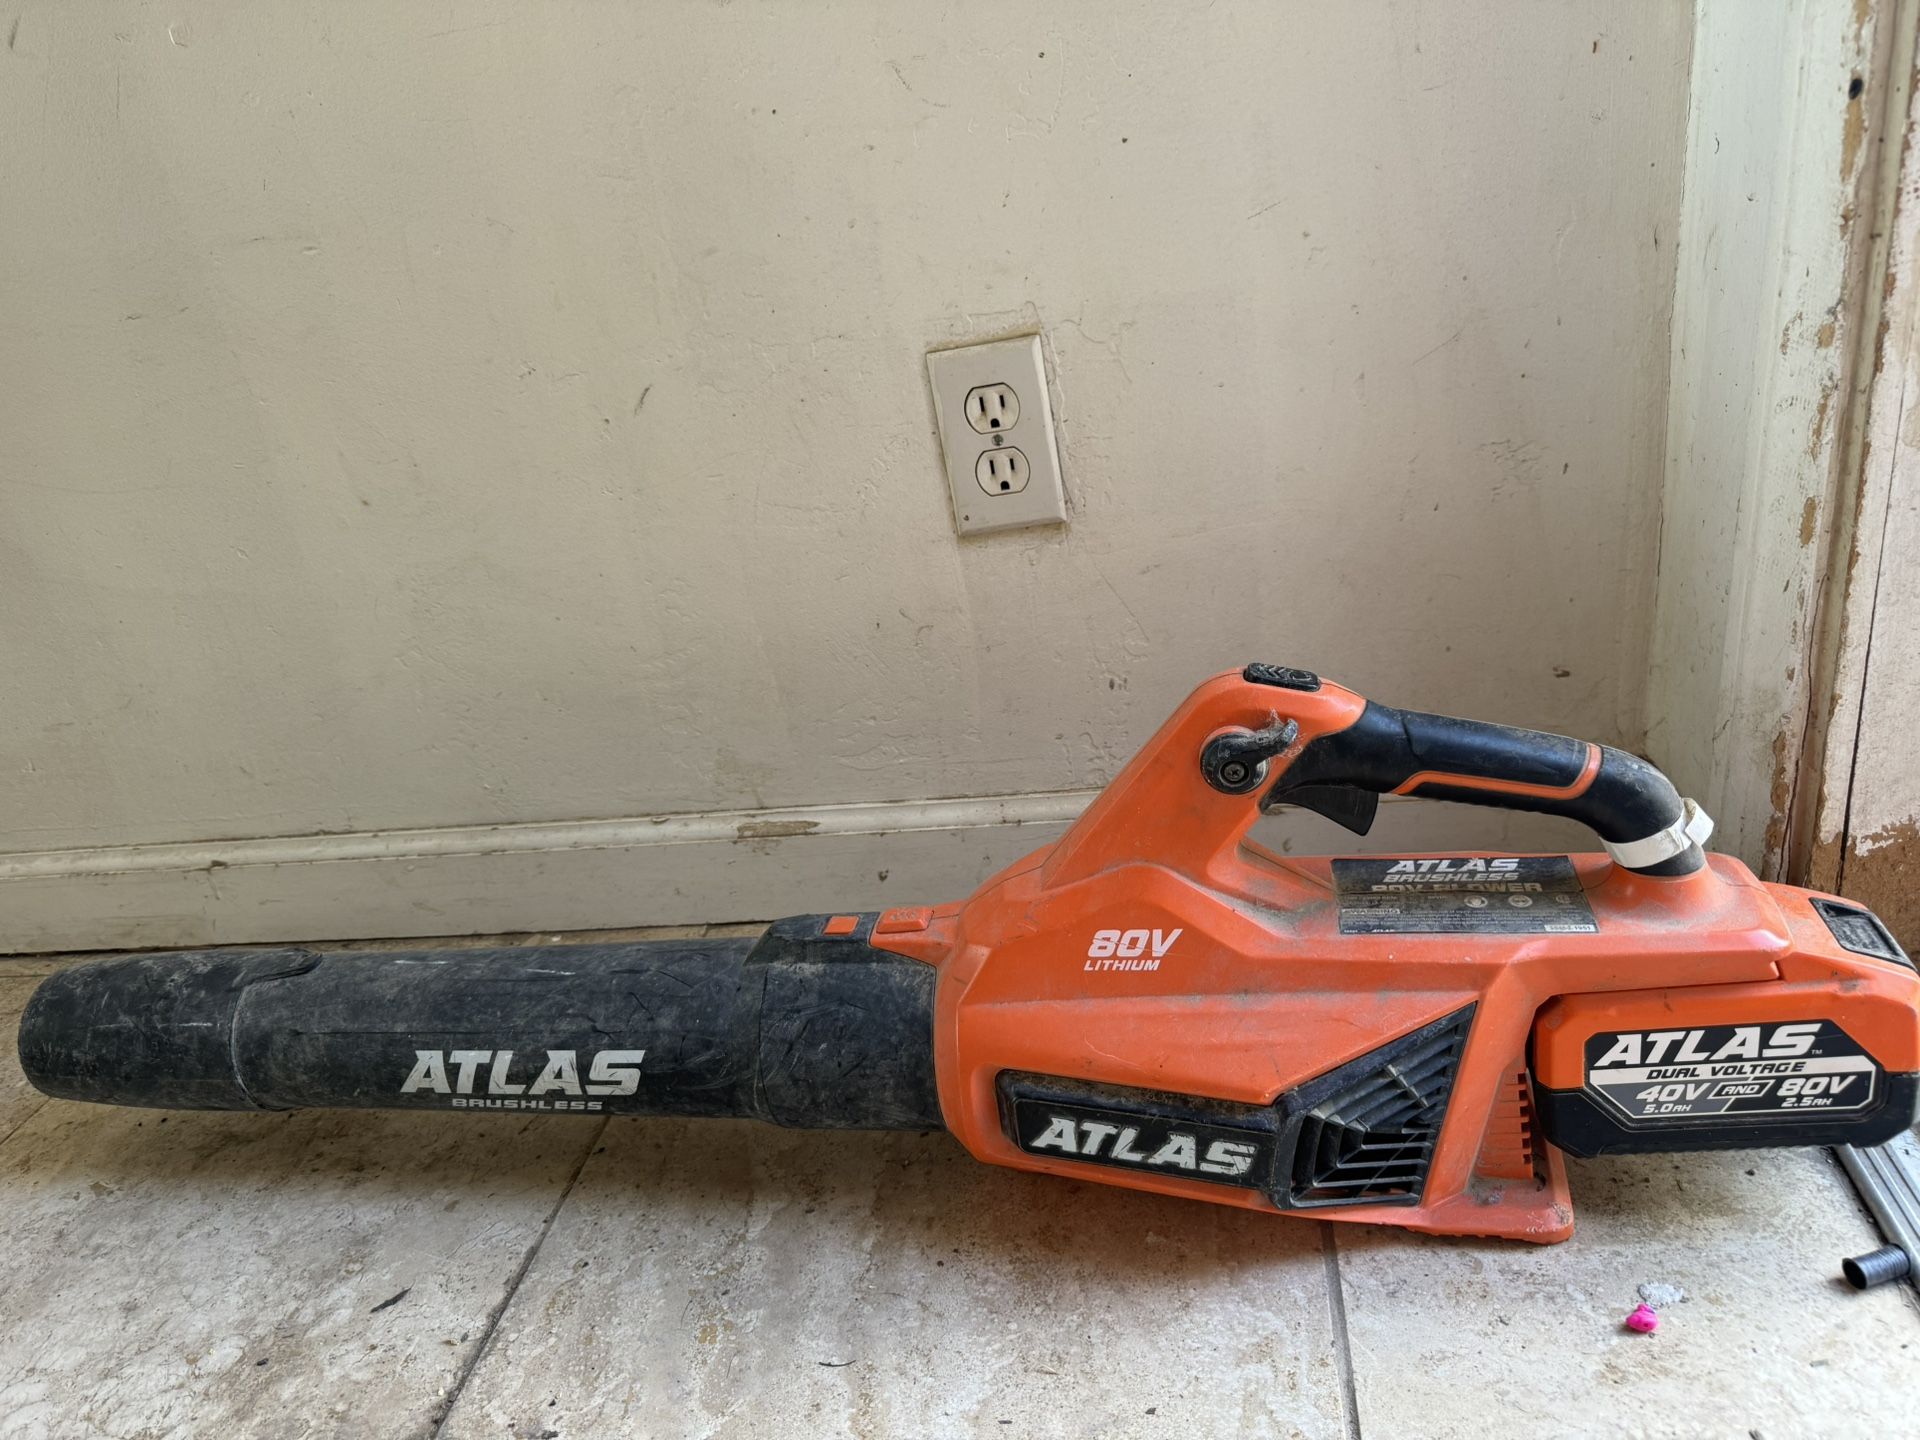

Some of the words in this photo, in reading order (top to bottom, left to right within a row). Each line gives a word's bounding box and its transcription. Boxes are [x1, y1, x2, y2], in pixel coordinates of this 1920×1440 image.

[1386, 858, 1520, 873] ATLAS
[1383, 872, 1520, 883] BRUSHLESS
[1087, 928, 1183, 957] 80V
[1083, 960, 1161, 971] LITHIUM
[1593, 1023, 1822, 1067] ATLAS
[400, 1050, 646, 1096] ATLAS
[1646, 1067, 1700, 1080] DUAL
[1711, 1062, 1806, 1076] VOLTAGE
[1635, 1082, 1711, 1102] 40V
[1721, 1084, 1760, 1096] AND
[1776, 1075, 1858, 1096] 80V
[452, 1098, 603, 1110] BRUSHLESS
[1031, 1117, 1256, 1176] ATLAS
